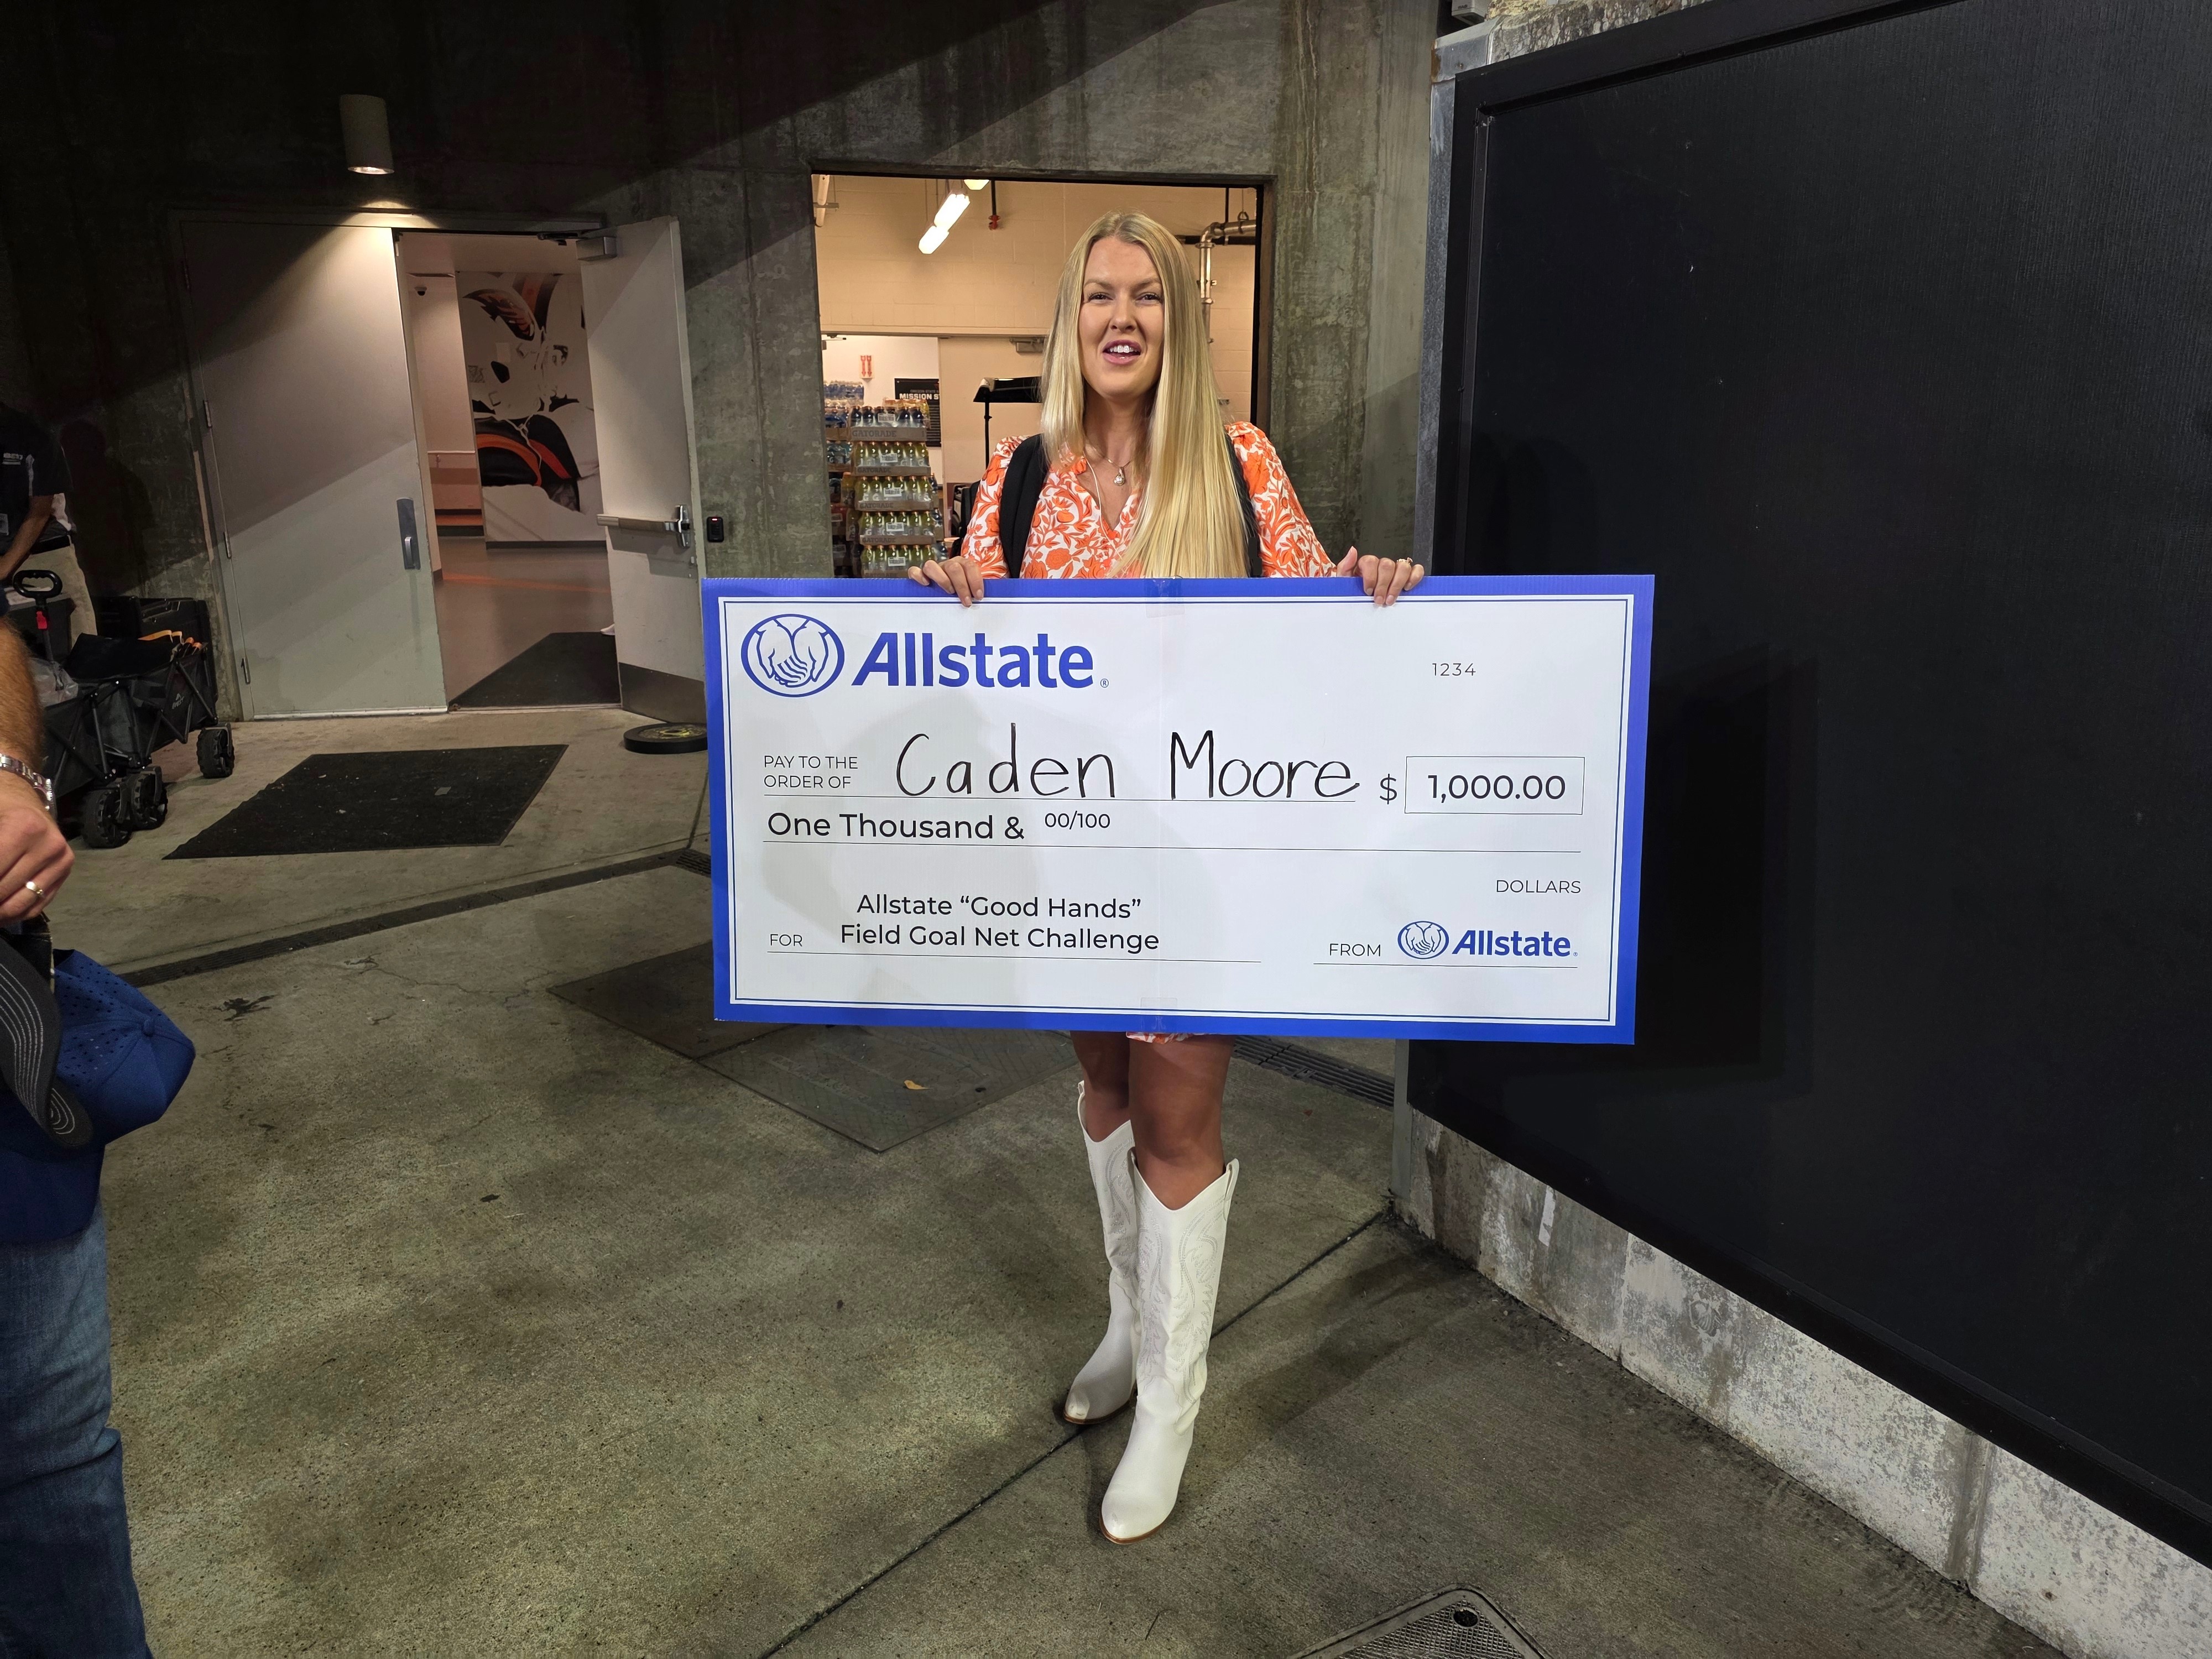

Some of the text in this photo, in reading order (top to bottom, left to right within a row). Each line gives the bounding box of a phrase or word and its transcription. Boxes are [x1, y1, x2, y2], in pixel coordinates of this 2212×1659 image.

[851, 632, 1093, 688] Allstate
[1432, 662, 1477, 676] 1234
[764, 755, 858, 769] PAY TO THE
[896, 722, 1360, 799] Caden Moore
[764, 775, 852, 789] ORDER OF
[1379, 773, 1566, 805] $ 1,000.00
[768, 810, 1110, 840] One Thousand & 00/100
[1496, 879, 1581, 894] DOLLARS
[856, 894, 1141, 919] Allstate “Good Hands”
[770, 933, 802, 947] FOR
[841, 923, 1159, 954] Field Goal Net Challenge
[1329, 930, 1571, 957] FROM Allstate
